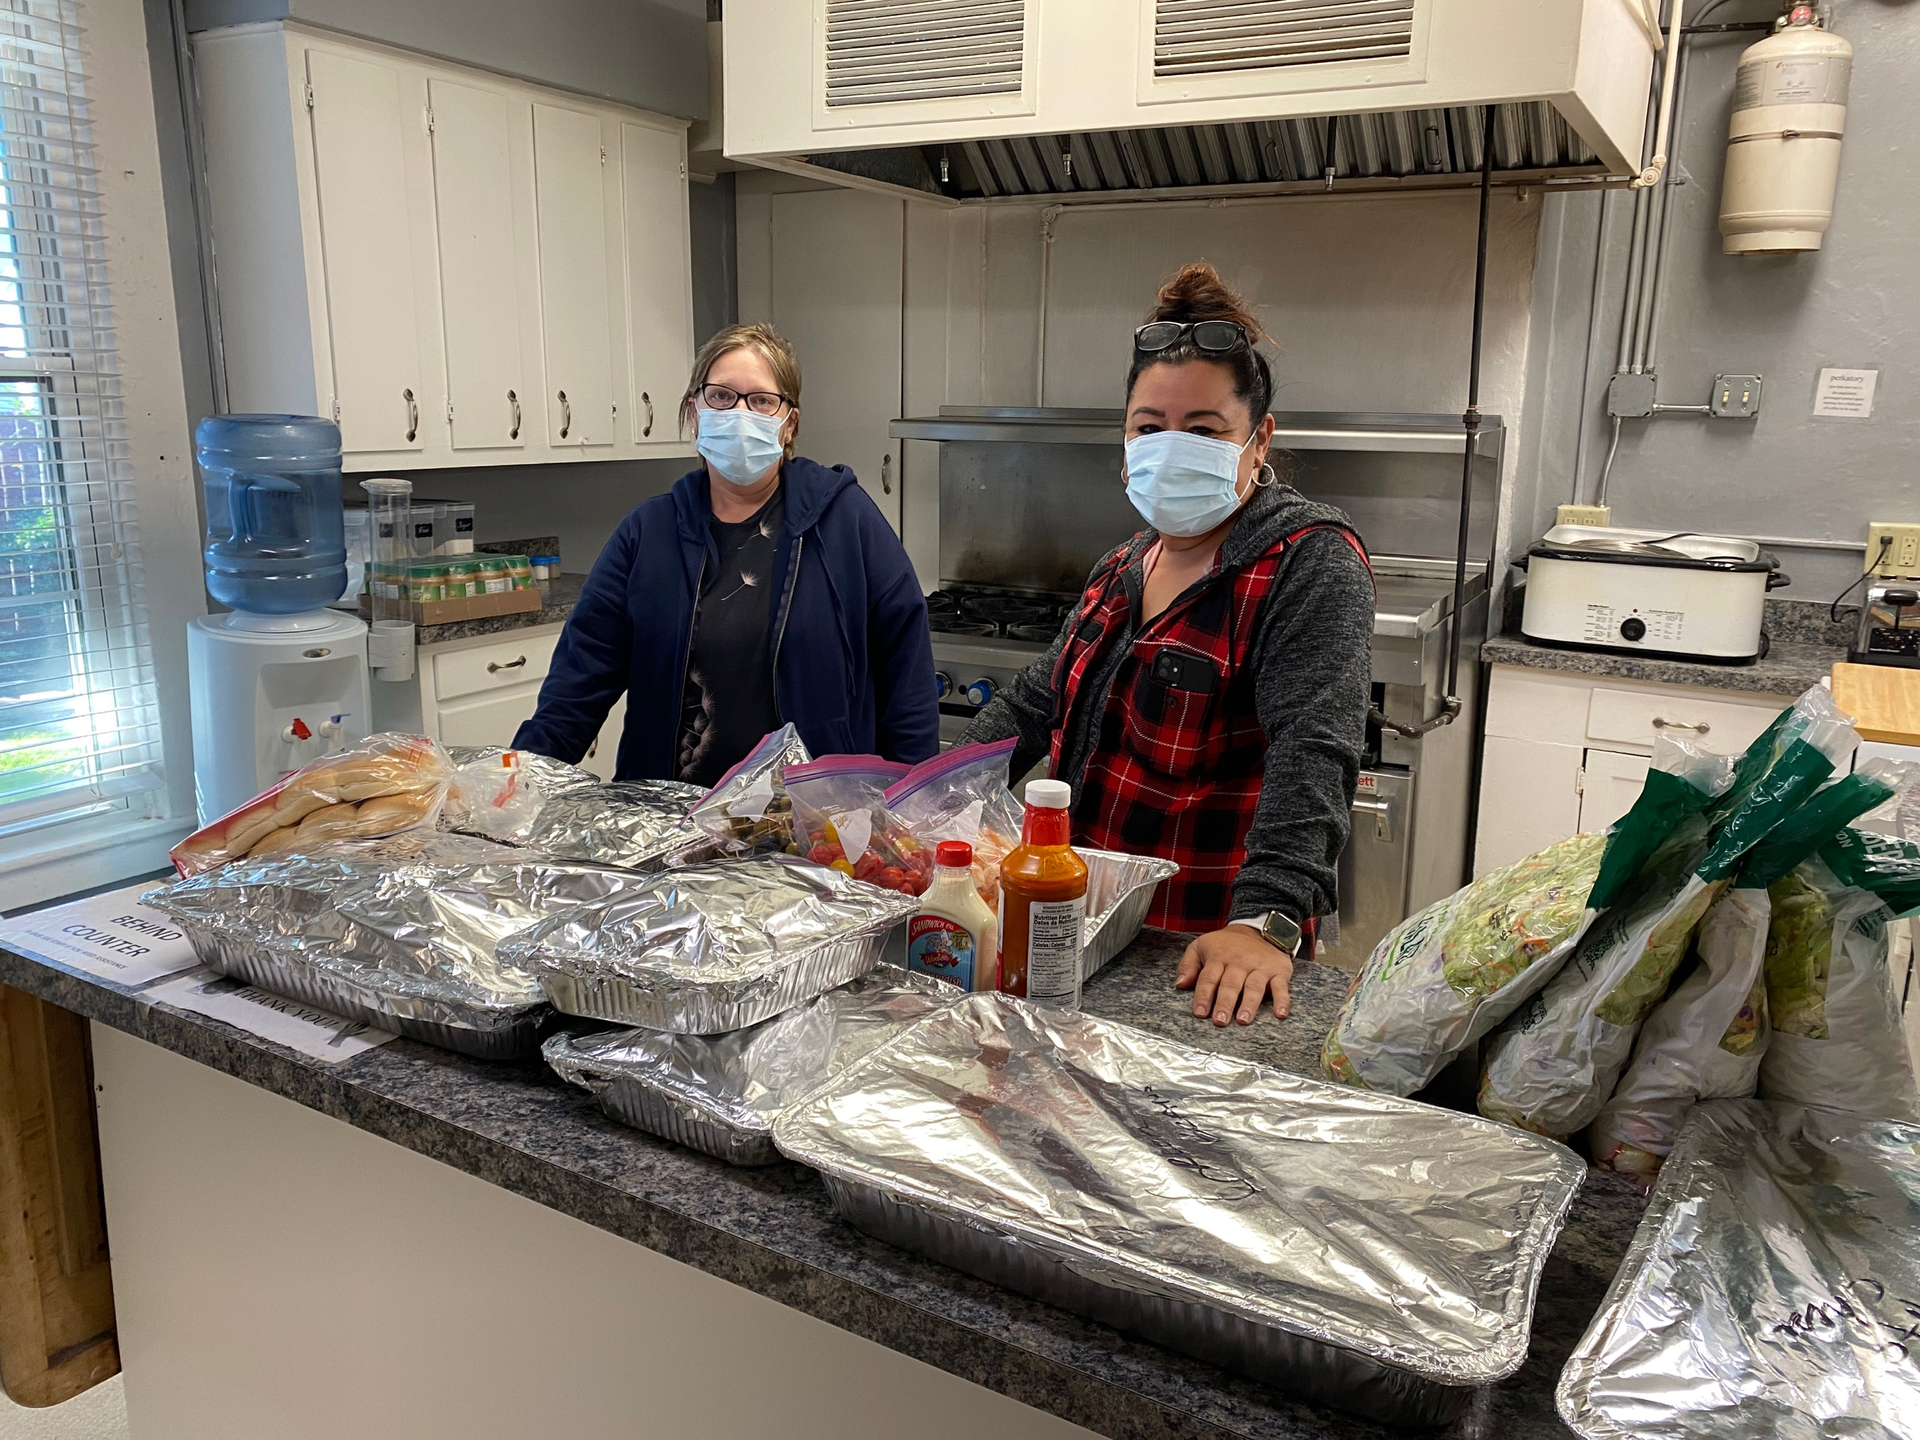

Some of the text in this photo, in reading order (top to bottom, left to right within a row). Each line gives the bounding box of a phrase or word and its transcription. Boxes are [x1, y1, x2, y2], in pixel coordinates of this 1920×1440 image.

[1830, 375, 1865, 384] perkatory
[110, 915, 183, 941] BEHIND
[912, 919, 945, 936] SANDWICH
[62, 924, 151, 957] COUNTER
[96, 954, 127, 969] ASSISTANCE
[234, 989, 340, 1028] THANK YOU!
